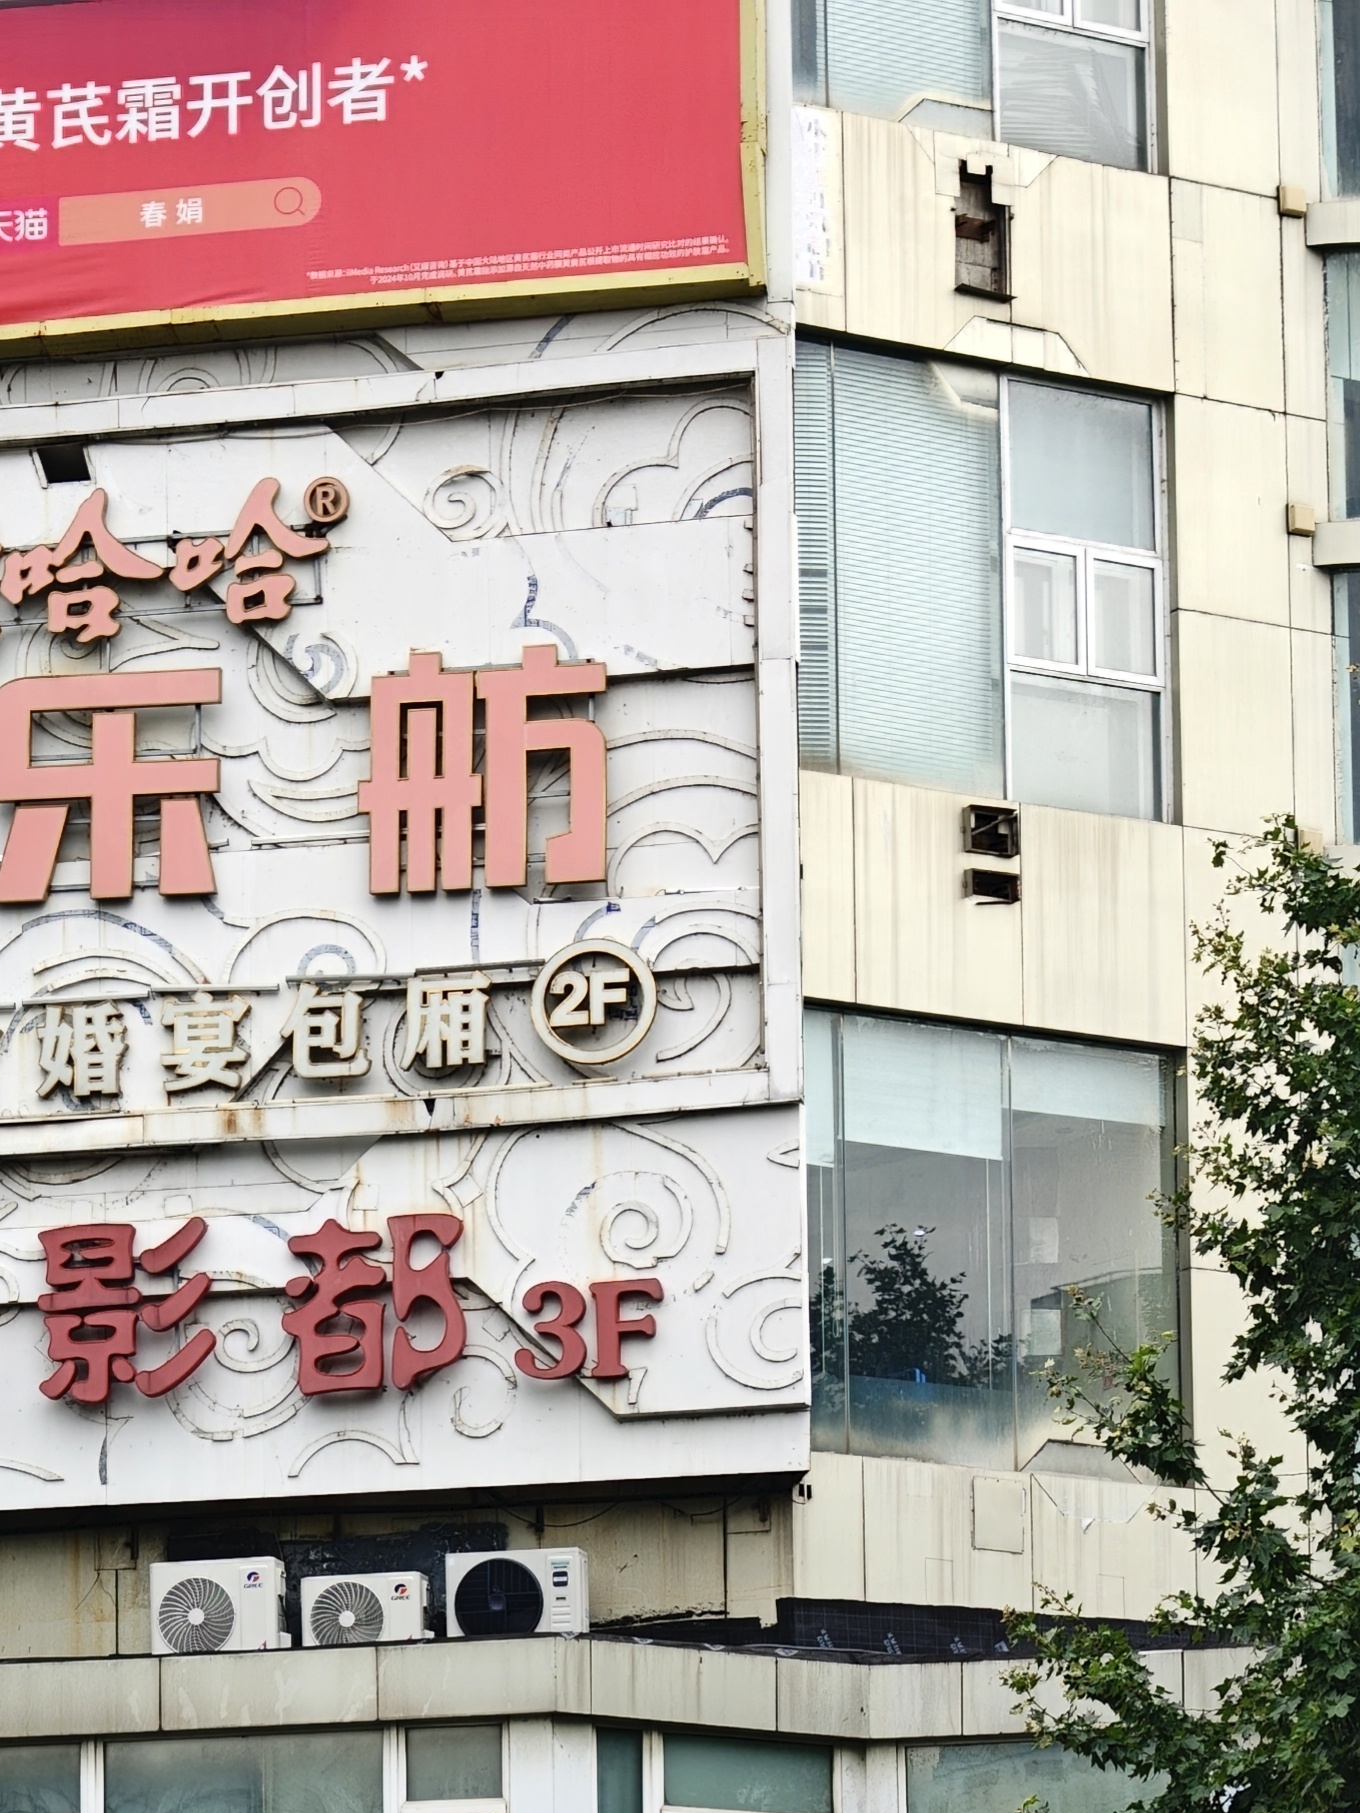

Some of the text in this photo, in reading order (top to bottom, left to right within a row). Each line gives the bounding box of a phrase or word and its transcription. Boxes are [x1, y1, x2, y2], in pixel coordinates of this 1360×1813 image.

[139, 197, 203, 229] 春娟
[549, 968, 634, 1027] 2F
[515, 1277, 664, 1383] 3F
